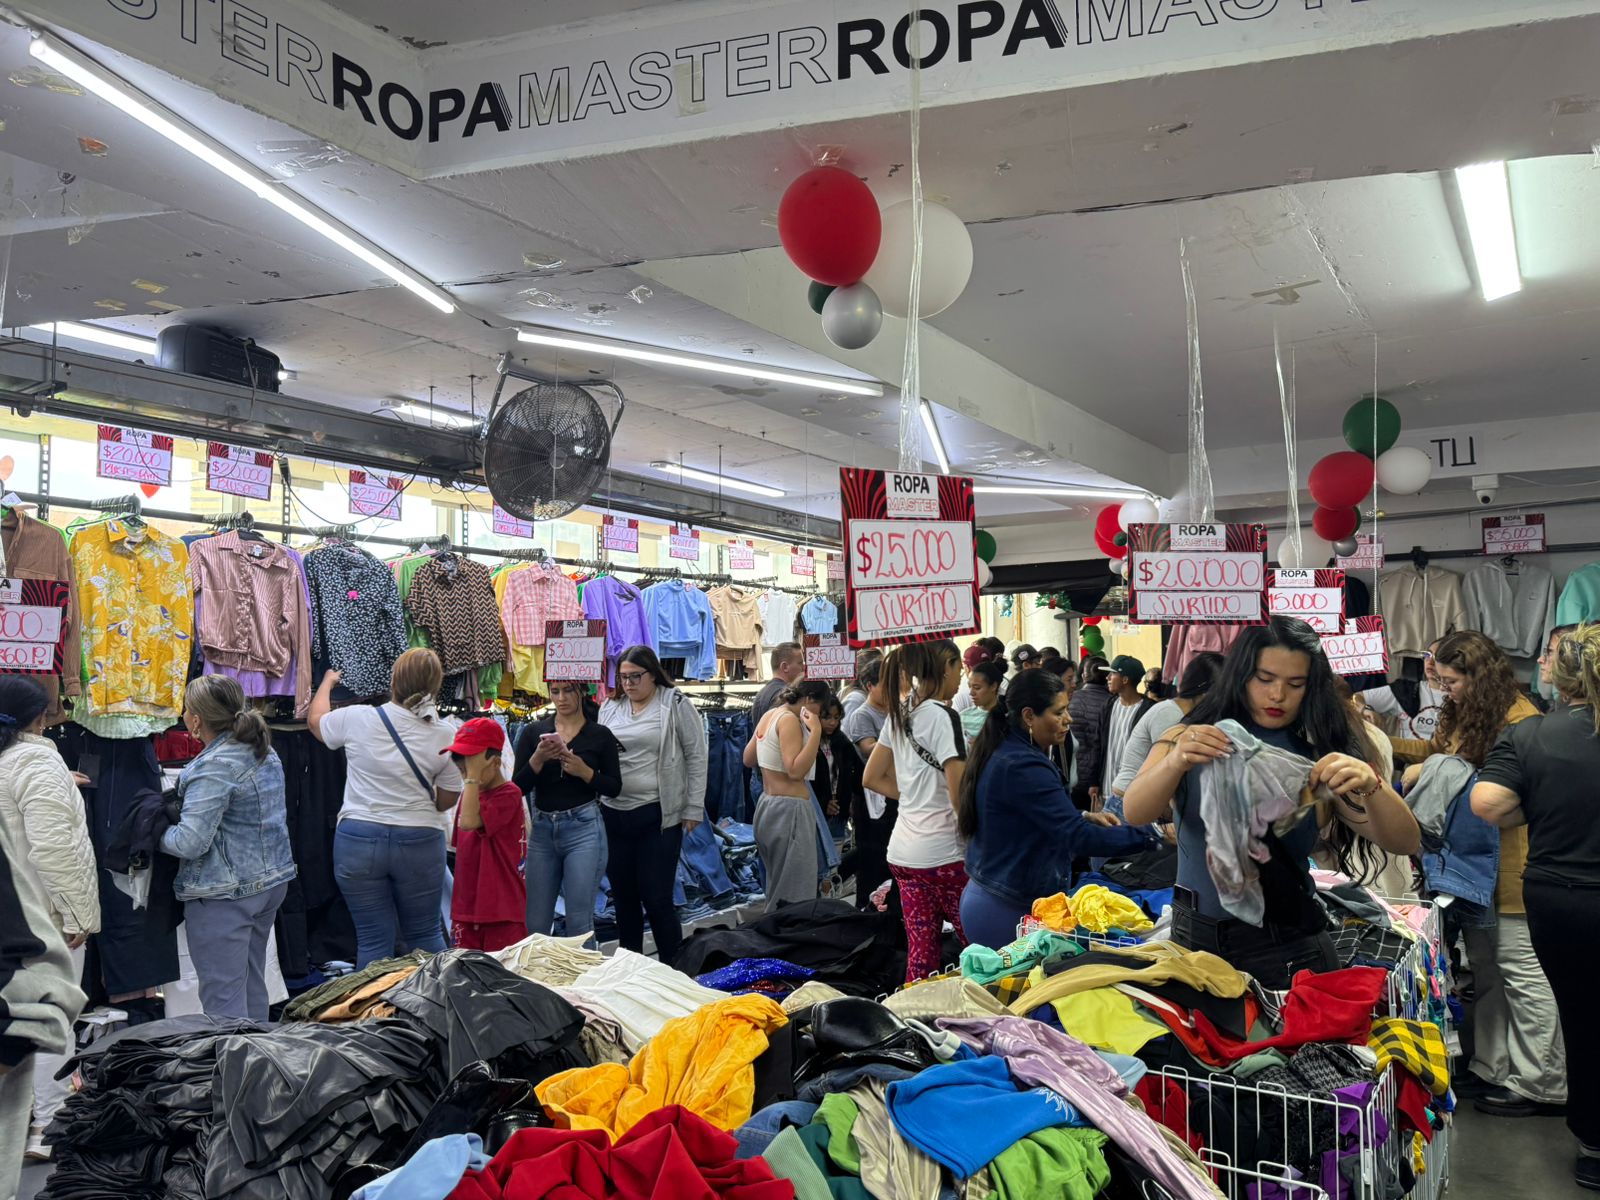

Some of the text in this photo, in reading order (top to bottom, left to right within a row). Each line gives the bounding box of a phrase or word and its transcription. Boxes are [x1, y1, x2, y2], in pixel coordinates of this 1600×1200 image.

[332, 52, 512, 143] ROPA
[519, 26, 832, 129] MASTER
[837, 0, 1069, 80] ROPA
[893, 474, 930, 494] ROPA
[887, 497, 939, 513] MASTER
[1178, 525, 1217, 536] ROPA
[1171, 537, 1225, 547] MASTER
[856, 528, 956, 579] $25.000
[1138, 558, 1260, 588] $20.000
[1280, 570, 1308, 578] ROPA
[1152, 594, 1241, 615] SURTIDO
[566, 620, 584, 628] ROPA
